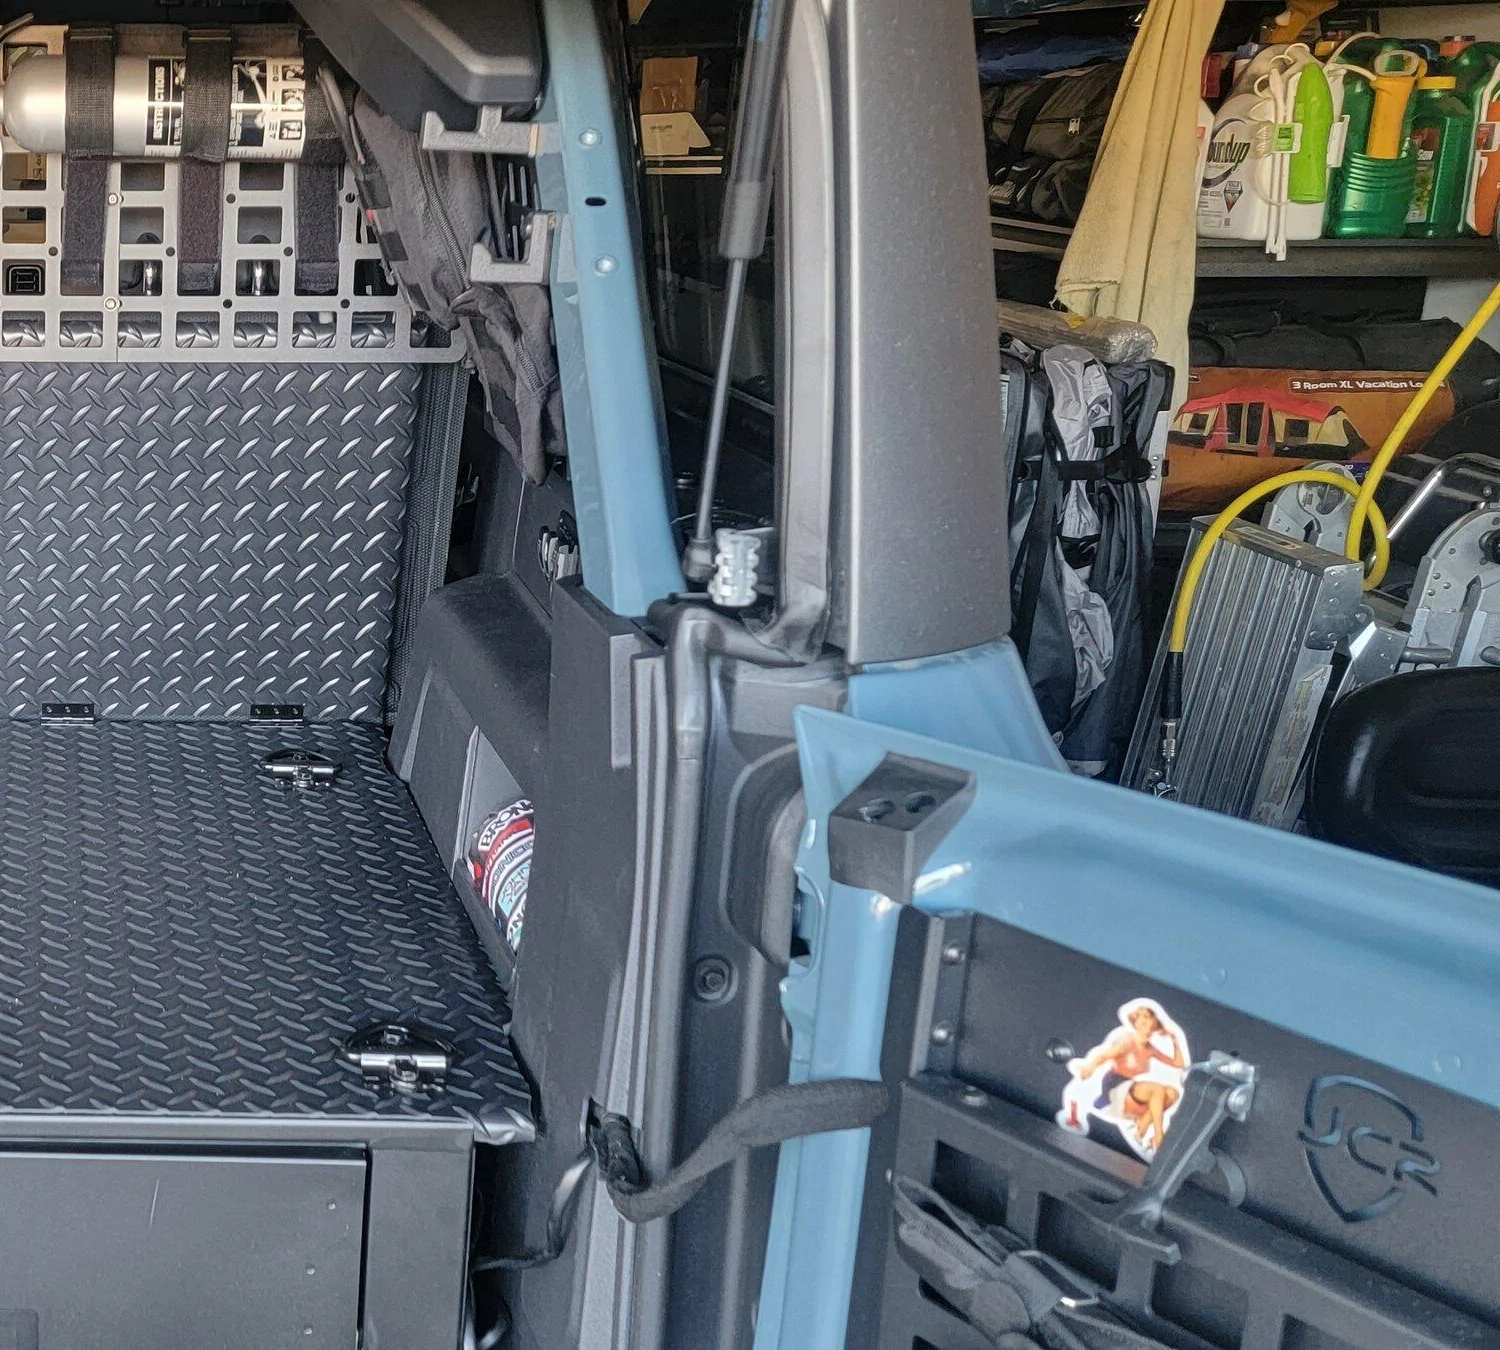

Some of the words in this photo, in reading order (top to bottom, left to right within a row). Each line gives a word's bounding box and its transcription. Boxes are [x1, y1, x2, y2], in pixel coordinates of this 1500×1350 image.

[153, 66, 165, 139] INSTRCTIONS
[1292, 381, 1301, 389] 3
[1303, 381, 1337, 390] Room
[1339, 380, 1354, 389] XL
[1355, 380, 1408, 389] Vacation
